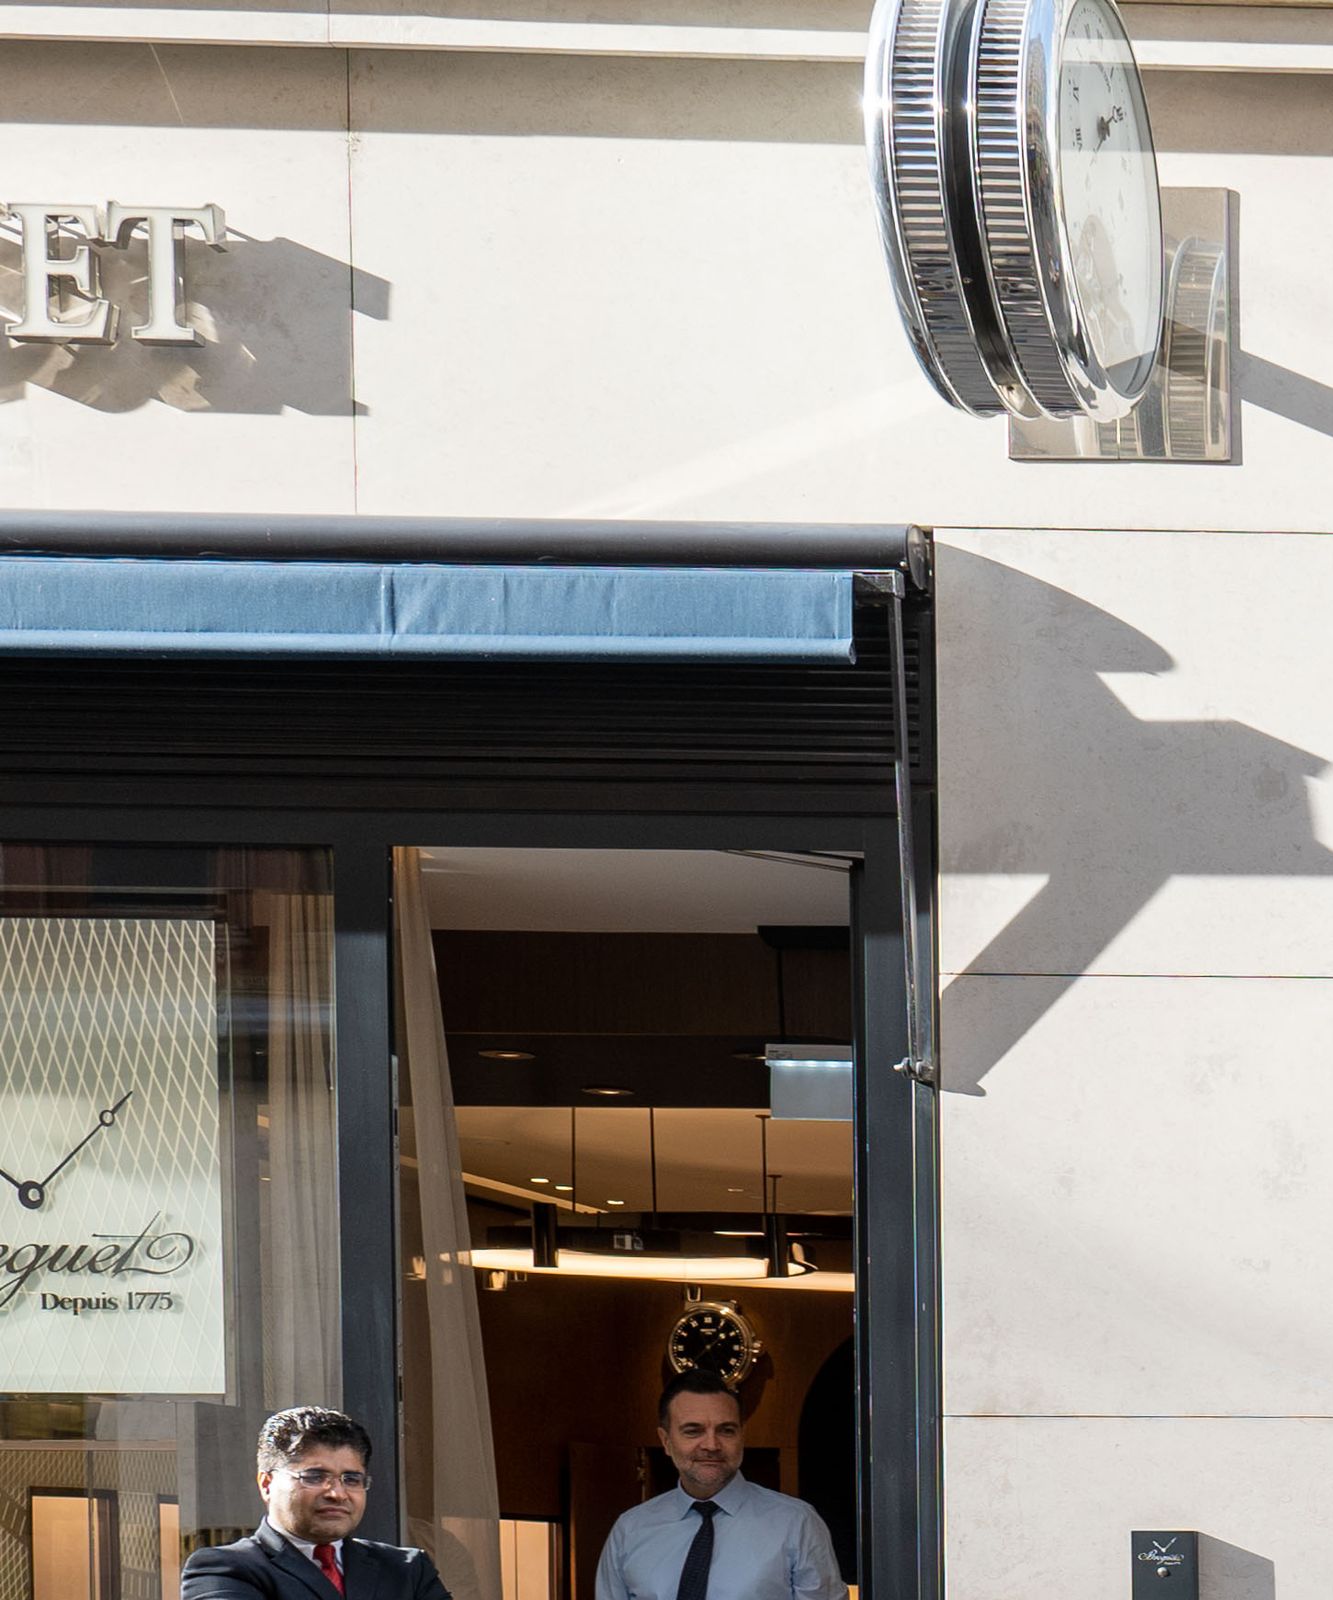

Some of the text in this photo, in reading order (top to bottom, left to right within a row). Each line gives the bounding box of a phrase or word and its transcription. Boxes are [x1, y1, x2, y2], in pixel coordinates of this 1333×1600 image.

[0, 200, 226, 348] ET
[0, 1210, 195, 1309] guet
[41, 1291, 174, 1316] Depuis 1775
